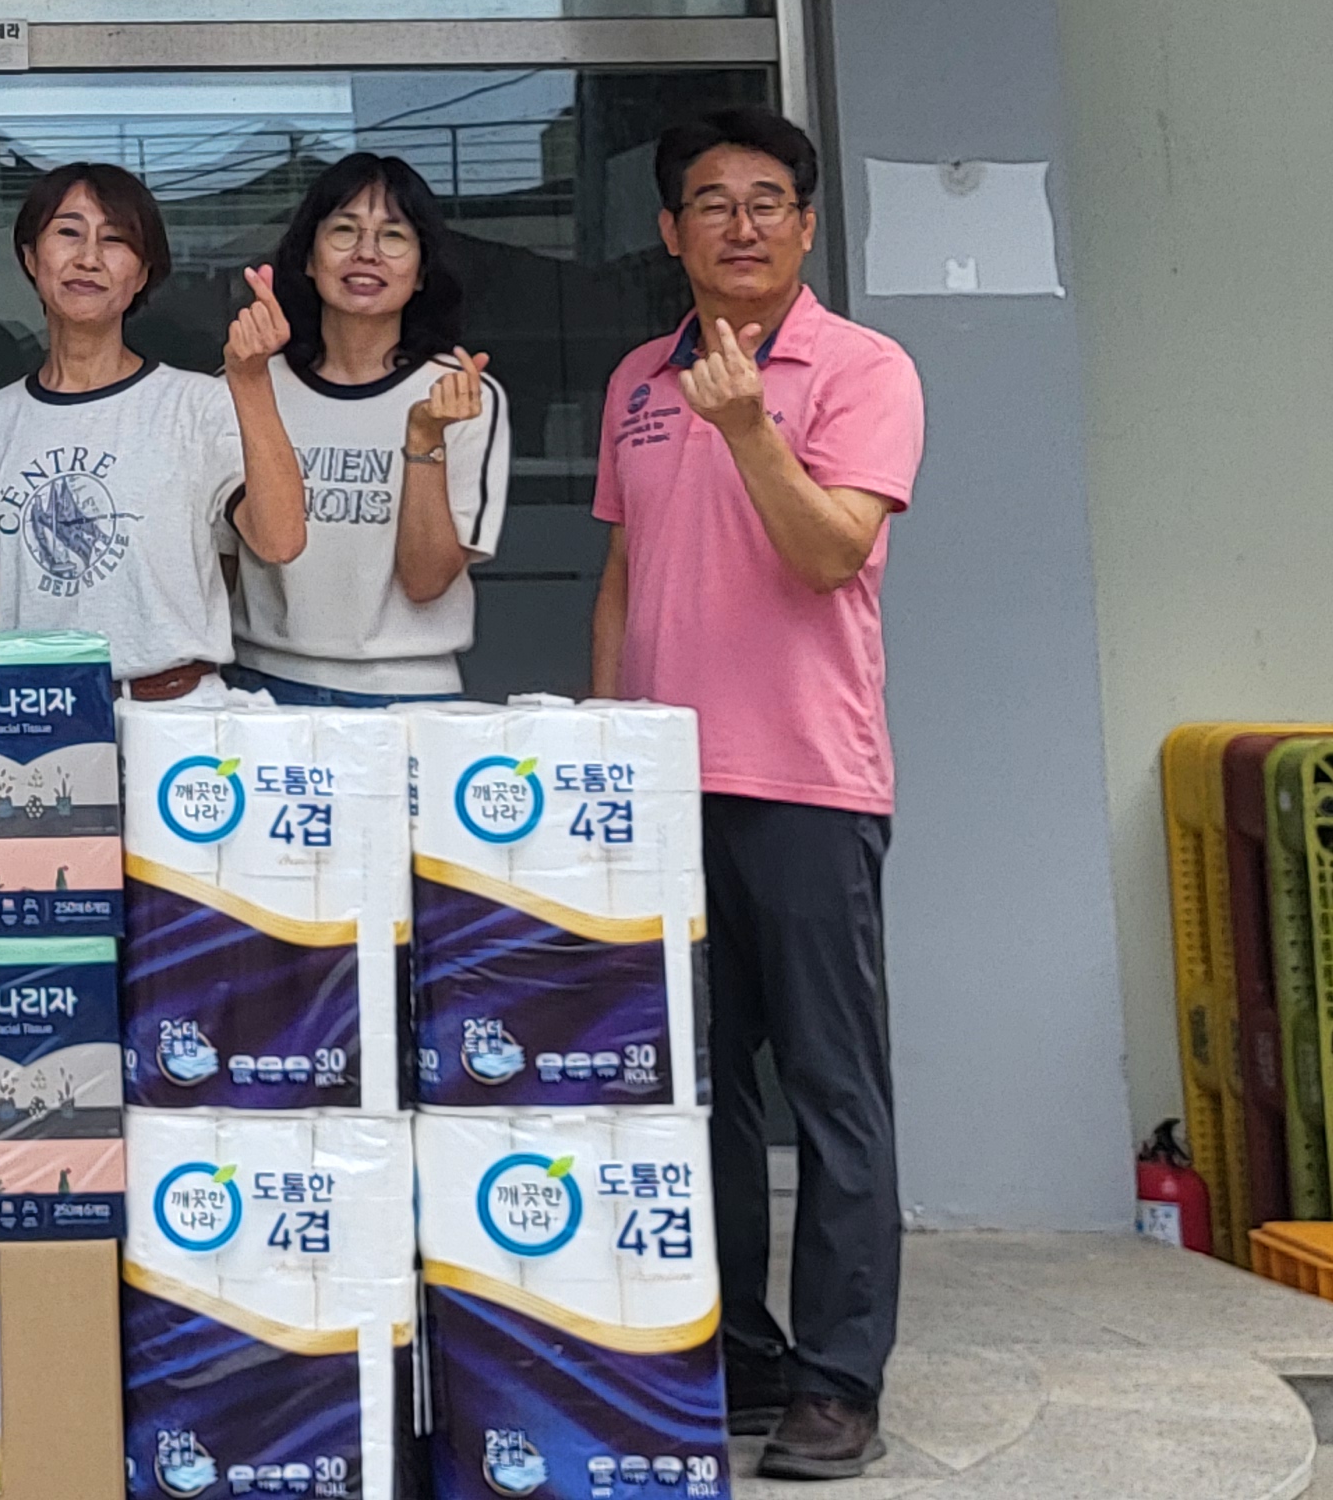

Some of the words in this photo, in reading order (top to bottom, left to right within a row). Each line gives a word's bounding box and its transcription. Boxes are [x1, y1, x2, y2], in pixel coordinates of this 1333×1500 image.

[254, 763, 334, 795] 도톰한
[553, 763, 634, 794] 도톰한
[175, 782, 229, 802] 깨끗한
[472, 782, 527, 802] 깨끗한
[184, 803, 219, 823] 나라
[269, 803, 332, 847] 4겹
[482, 803, 519, 822] 나라
[569, 800, 634, 844] 4겹
[314, 1047, 346, 1071] 30
[624, 1044, 657, 1068] 30
[252, 1172, 335, 1203] 도톰한
[596, 1163, 692, 1199] 도톰한
[171, 1190, 226, 1210] 깨끗한
[497, 1184, 563, 1206] 깨끗한
[181, 1210, 217, 1231] 나라
[509, 1207, 553, 1231] 나라
[268, 1210, 331, 1254] 4겹
[616, 1208, 693, 1260] 4겹
[315, 1456, 348, 1482] 30
[686, 1455, 719, 1482] 30
